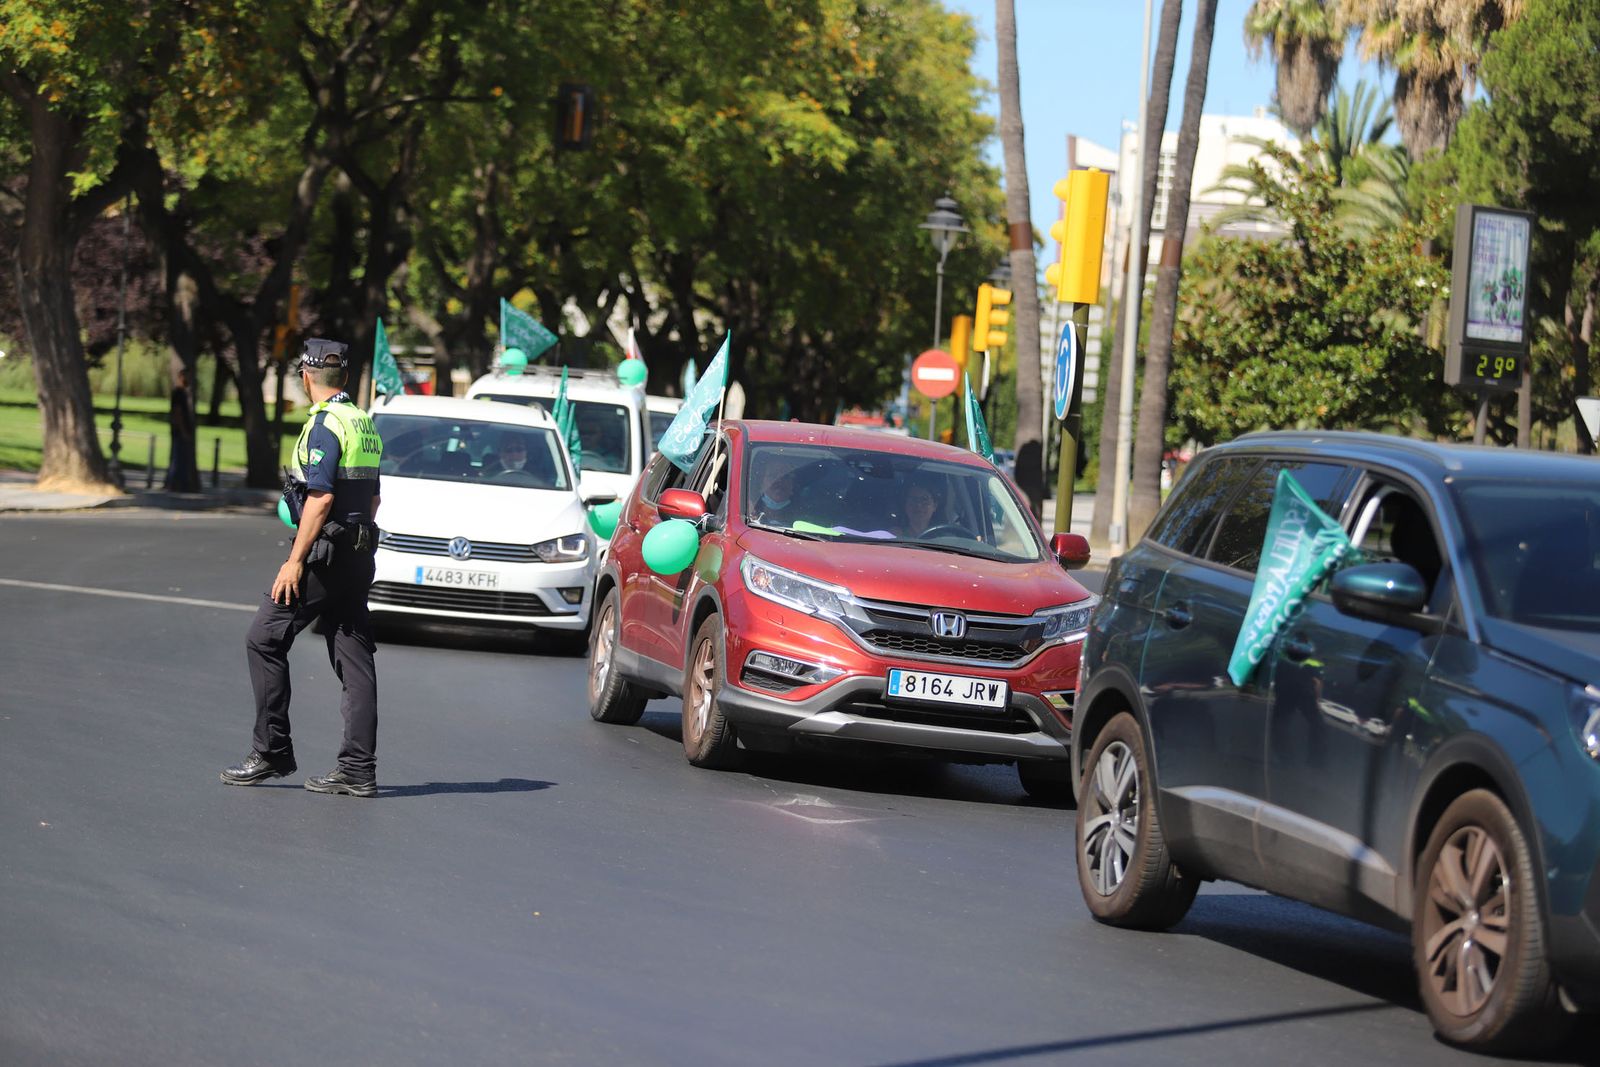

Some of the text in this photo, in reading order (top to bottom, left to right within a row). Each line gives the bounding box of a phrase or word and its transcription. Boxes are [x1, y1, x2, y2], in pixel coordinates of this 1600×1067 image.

[350, 418, 377, 435] POLIC
[361, 437, 380, 455] LOCAL
[426, 569, 497, 588] 4483 KFH
[905, 675, 999, 701] 8164 JRW
